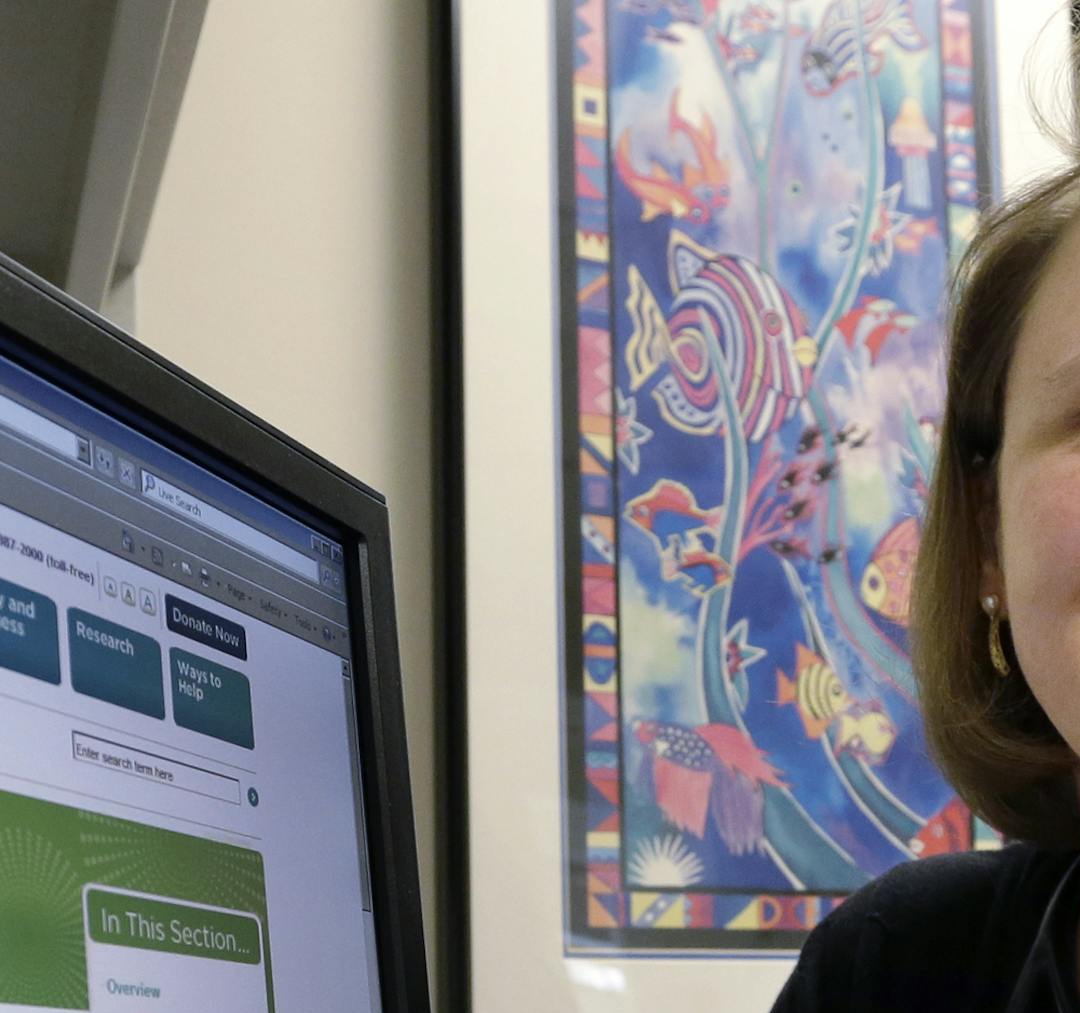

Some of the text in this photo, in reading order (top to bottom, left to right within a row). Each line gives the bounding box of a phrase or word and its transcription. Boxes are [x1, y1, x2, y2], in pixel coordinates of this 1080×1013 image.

[174, 494, 202, 517] Search
[46, 554, 94, 587] (toll-free)
[7, 597, 36, 619] and
[75, 620, 135, 657] Research
[172, 607, 241, 648] Donate Now
[176, 658, 222, 688] Ways to
[178, 679, 204, 701] Help
[77, 743, 174, 782] Enter search term here
[101, 908, 250, 954] In This Section...
[107, 978, 161, 998] Overview
